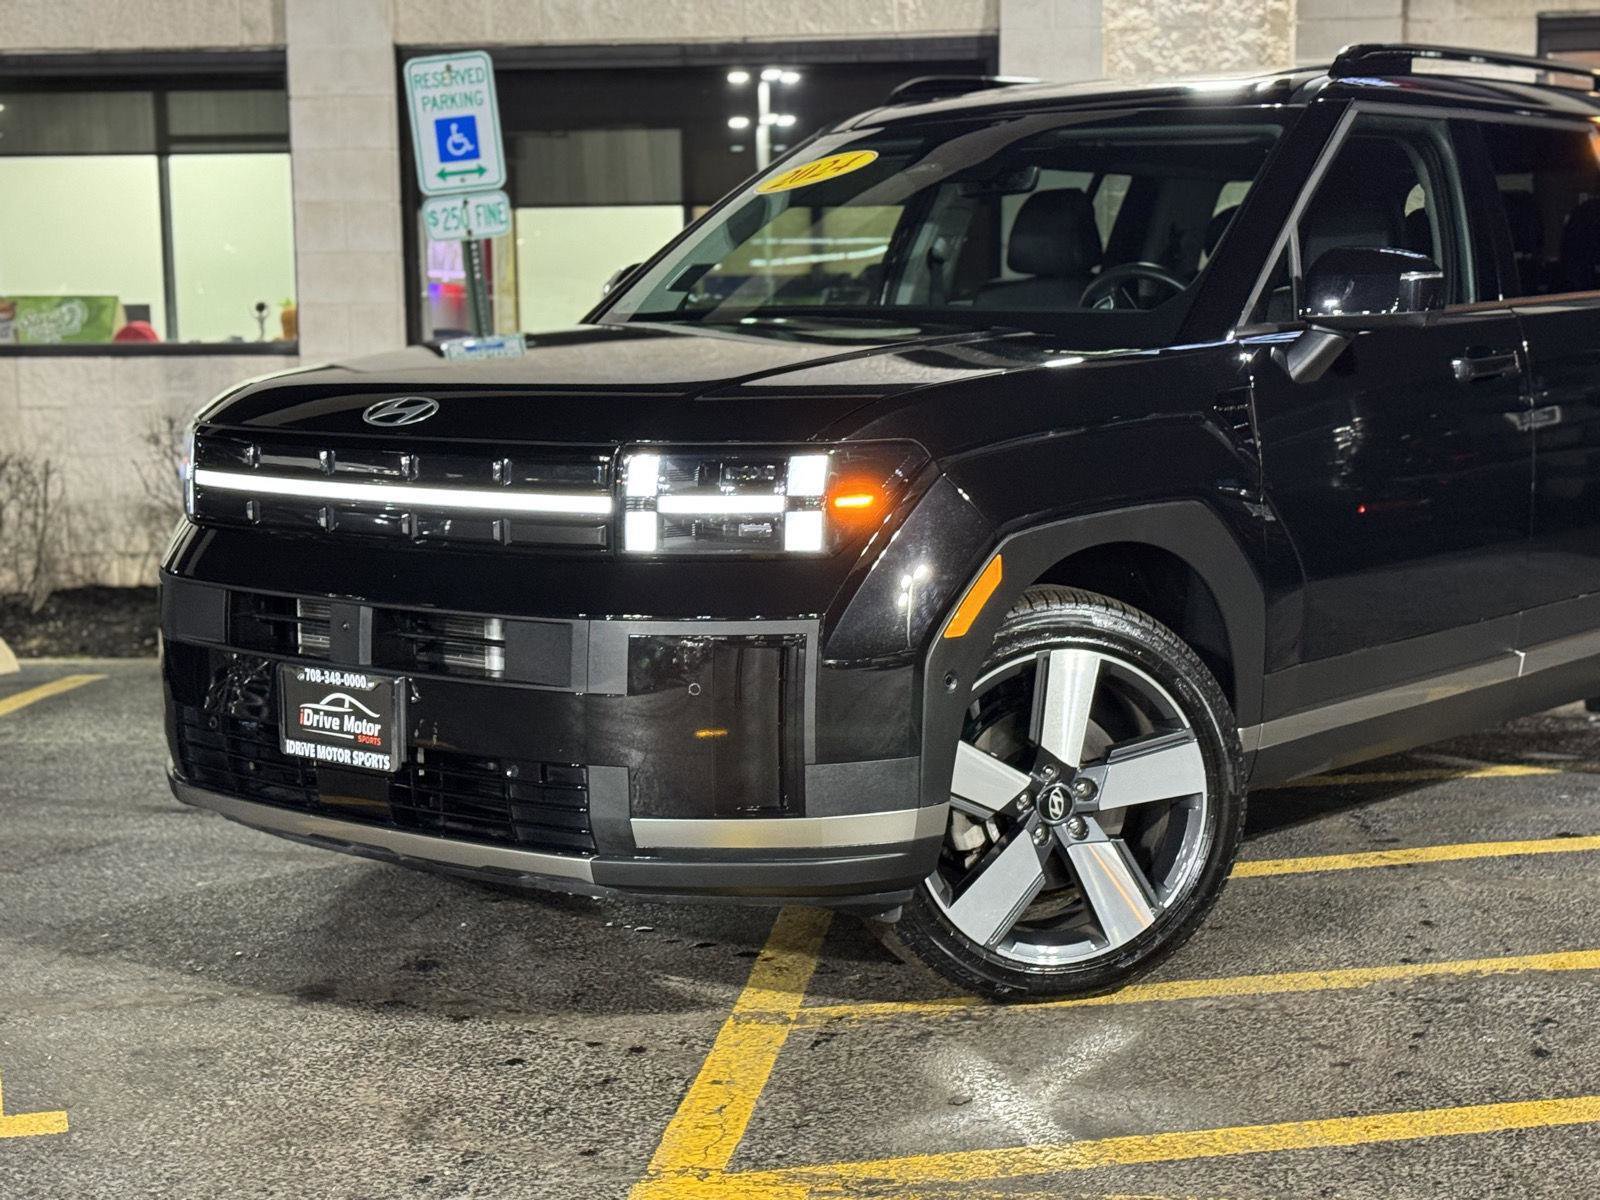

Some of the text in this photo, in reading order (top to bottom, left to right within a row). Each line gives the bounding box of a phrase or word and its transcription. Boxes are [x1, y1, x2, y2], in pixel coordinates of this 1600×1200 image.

[413, 66, 486, 90] RESERVED
[422, 91, 484, 112] PARKING
[476, 202, 508, 227] FINE
[304, 668, 367, 688] 708-348-0000
[299, 708, 382, 736] iDrive Motor
[357, 734, 382, 746] SPORTS
[316, 745, 352, 764] MOTOR
[352, 750, 391, 770] SPORTS
